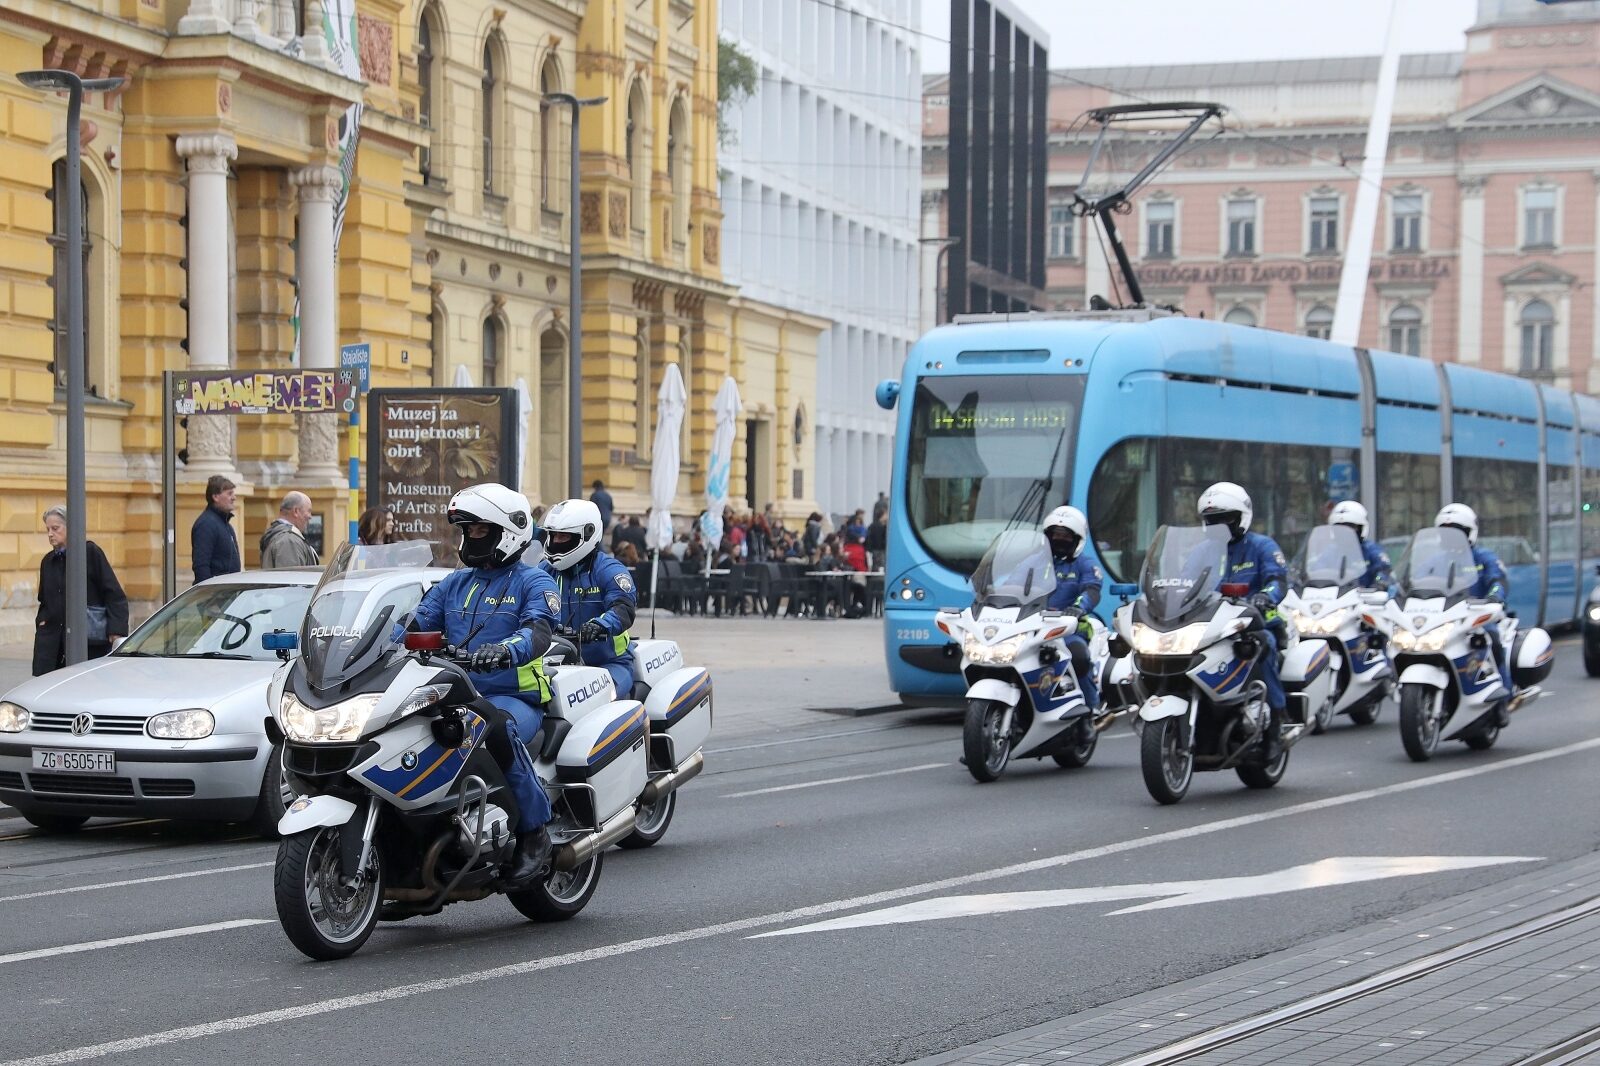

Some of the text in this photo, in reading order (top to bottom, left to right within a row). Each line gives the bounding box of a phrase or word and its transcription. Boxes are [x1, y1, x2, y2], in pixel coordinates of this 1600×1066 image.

[387, 406, 458, 423] Muzej za
[387, 424, 480, 442] umjetnost i
[388, 444, 423, 458] obrt
[387, 482, 452, 495] Museum
[387, 500, 403, 514] of
[406, 501, 436, 514] Arts
[310, 626, 363, 640] POLICIJA
[645, 645, 680, 674] POLICIJA
[566, 673, 612, 708] POLICIJA
[41, 752, 56, 768] ZG
